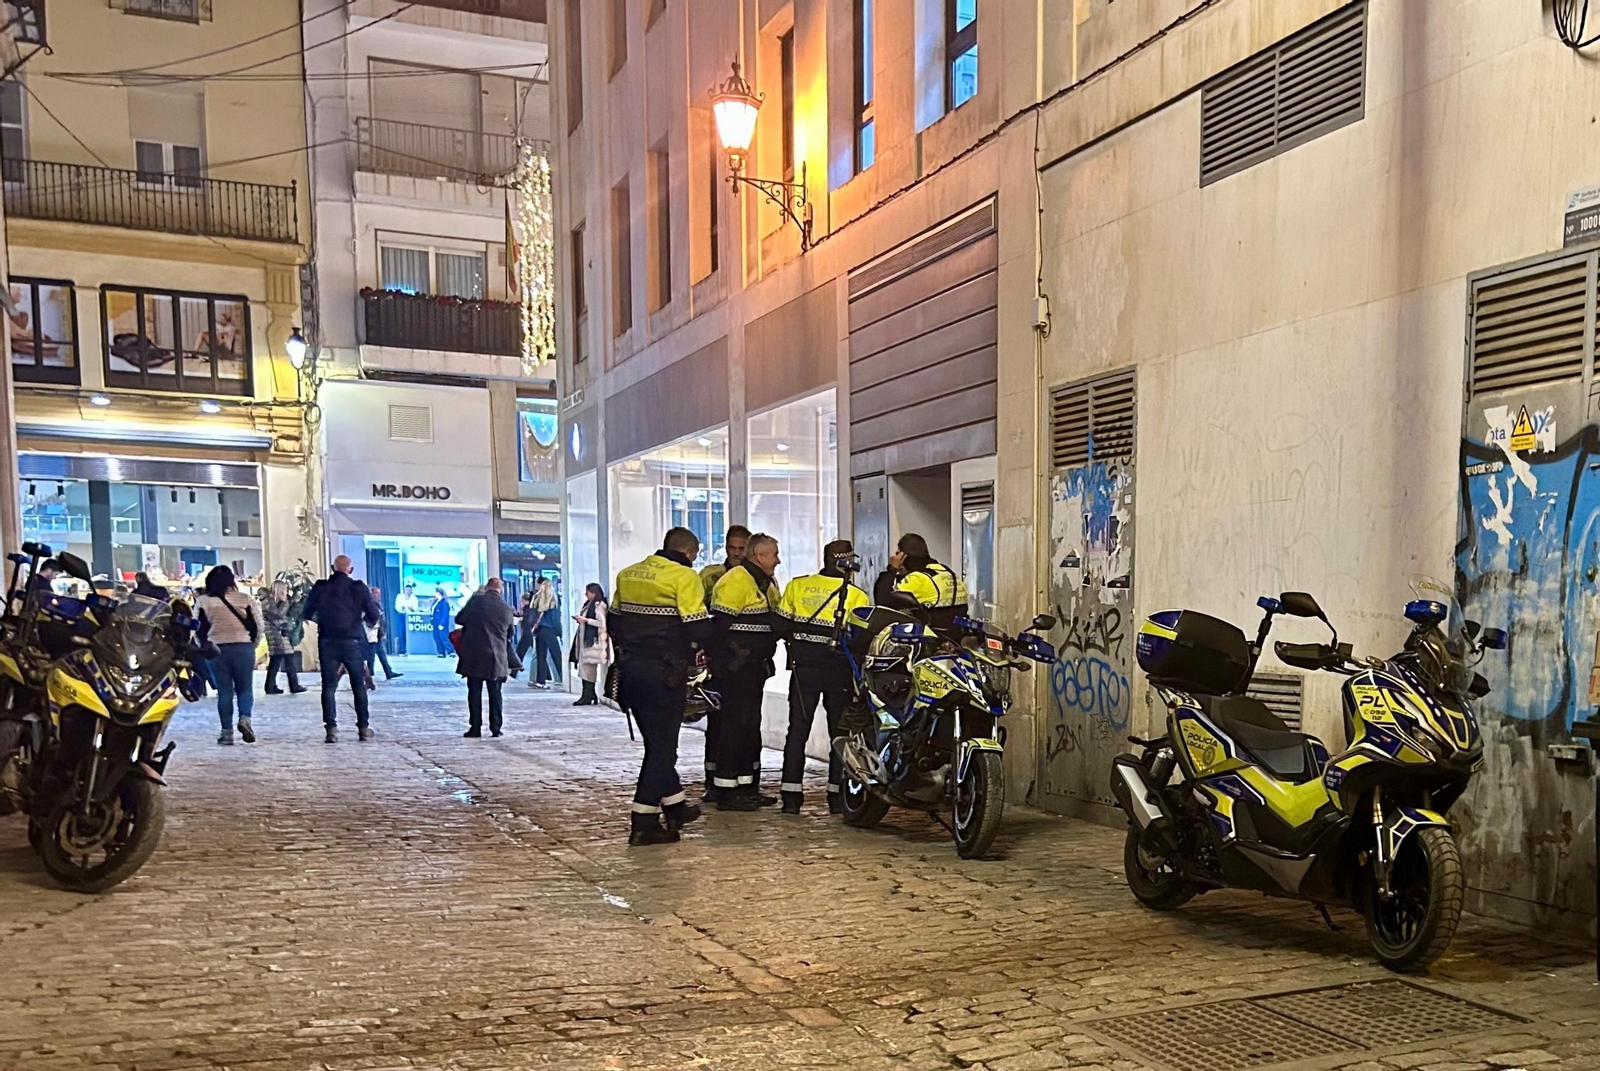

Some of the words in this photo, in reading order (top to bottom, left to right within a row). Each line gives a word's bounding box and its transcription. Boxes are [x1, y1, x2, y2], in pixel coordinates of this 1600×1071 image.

[372, 483, 451, 500] MR.BOHO
[412, 568, 453, 577] MR.BOHO
[625, 570, 657, 581] SEVILLA
[408, 615, 424, 623] MR.
[920, 679, 949, 691] POLICÍA
[1359, 695, 1385, 708] PL
[1186, 739, 1205, 751] LOCAL
